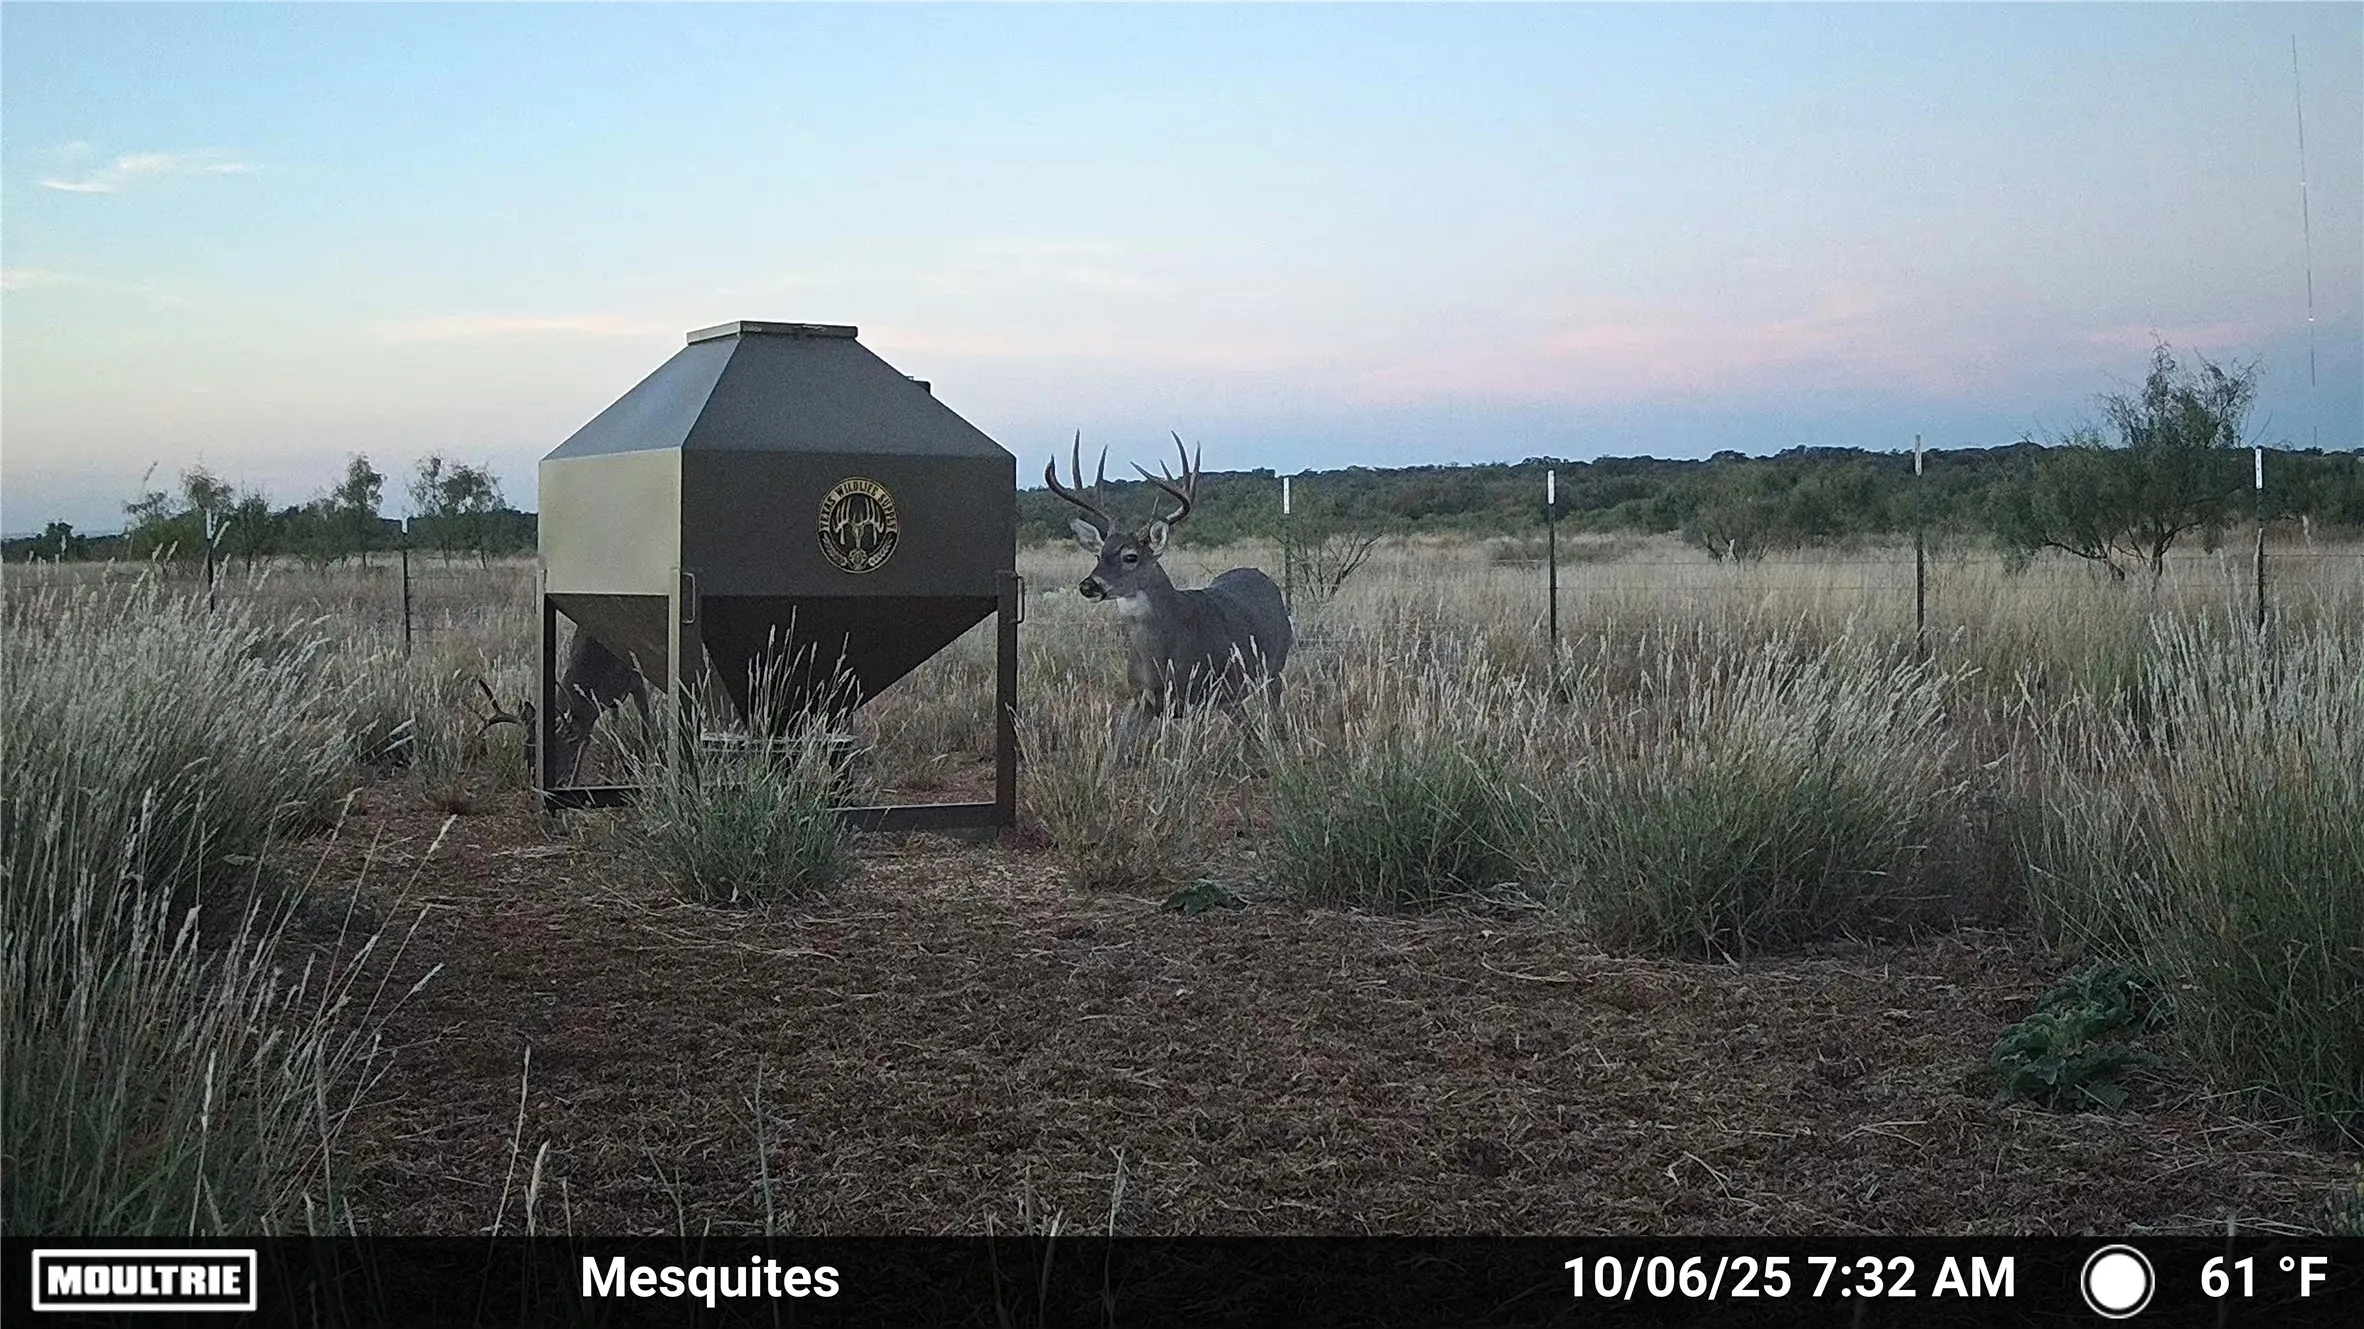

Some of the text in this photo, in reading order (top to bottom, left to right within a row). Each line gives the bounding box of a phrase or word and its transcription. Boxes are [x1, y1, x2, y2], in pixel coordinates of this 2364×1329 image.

[820, 480, 896, 530] TEXAS WILDLIFE SUPPLY
